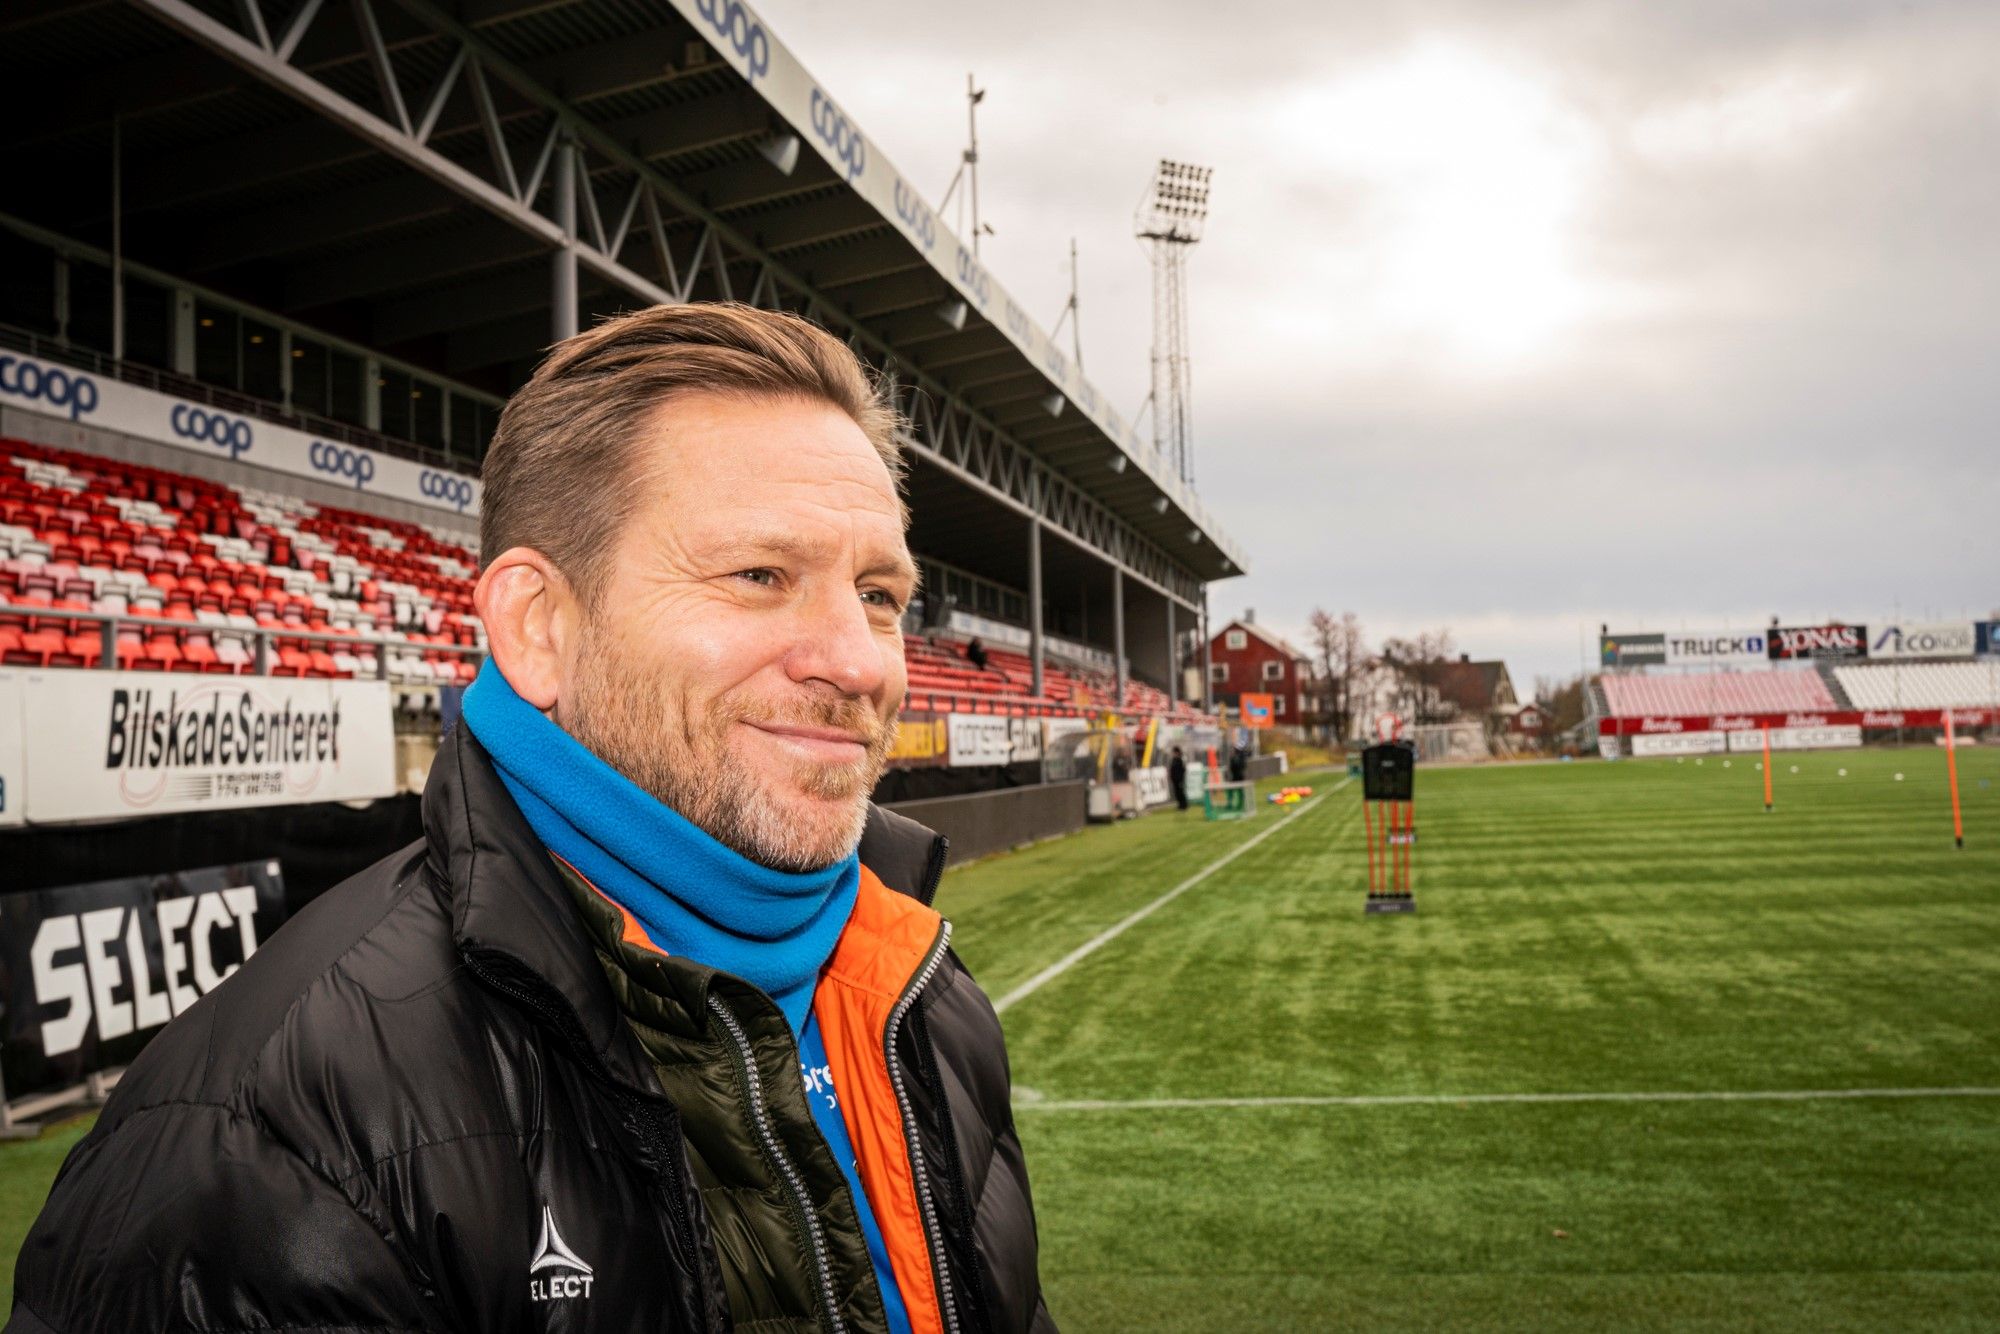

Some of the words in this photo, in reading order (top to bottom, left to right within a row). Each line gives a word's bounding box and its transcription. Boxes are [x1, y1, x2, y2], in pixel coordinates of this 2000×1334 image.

[811, 87, 864, 182] coop
[0, 356, 97, 422] coop
[171, 403, 252, 460] coop
[310, 441, 374, 491] coop
[420, 470, 472, 513] coop
[106, 689, 341, 769] BilskadeSenteret
[30, 885, 258, 1057] SELECT
